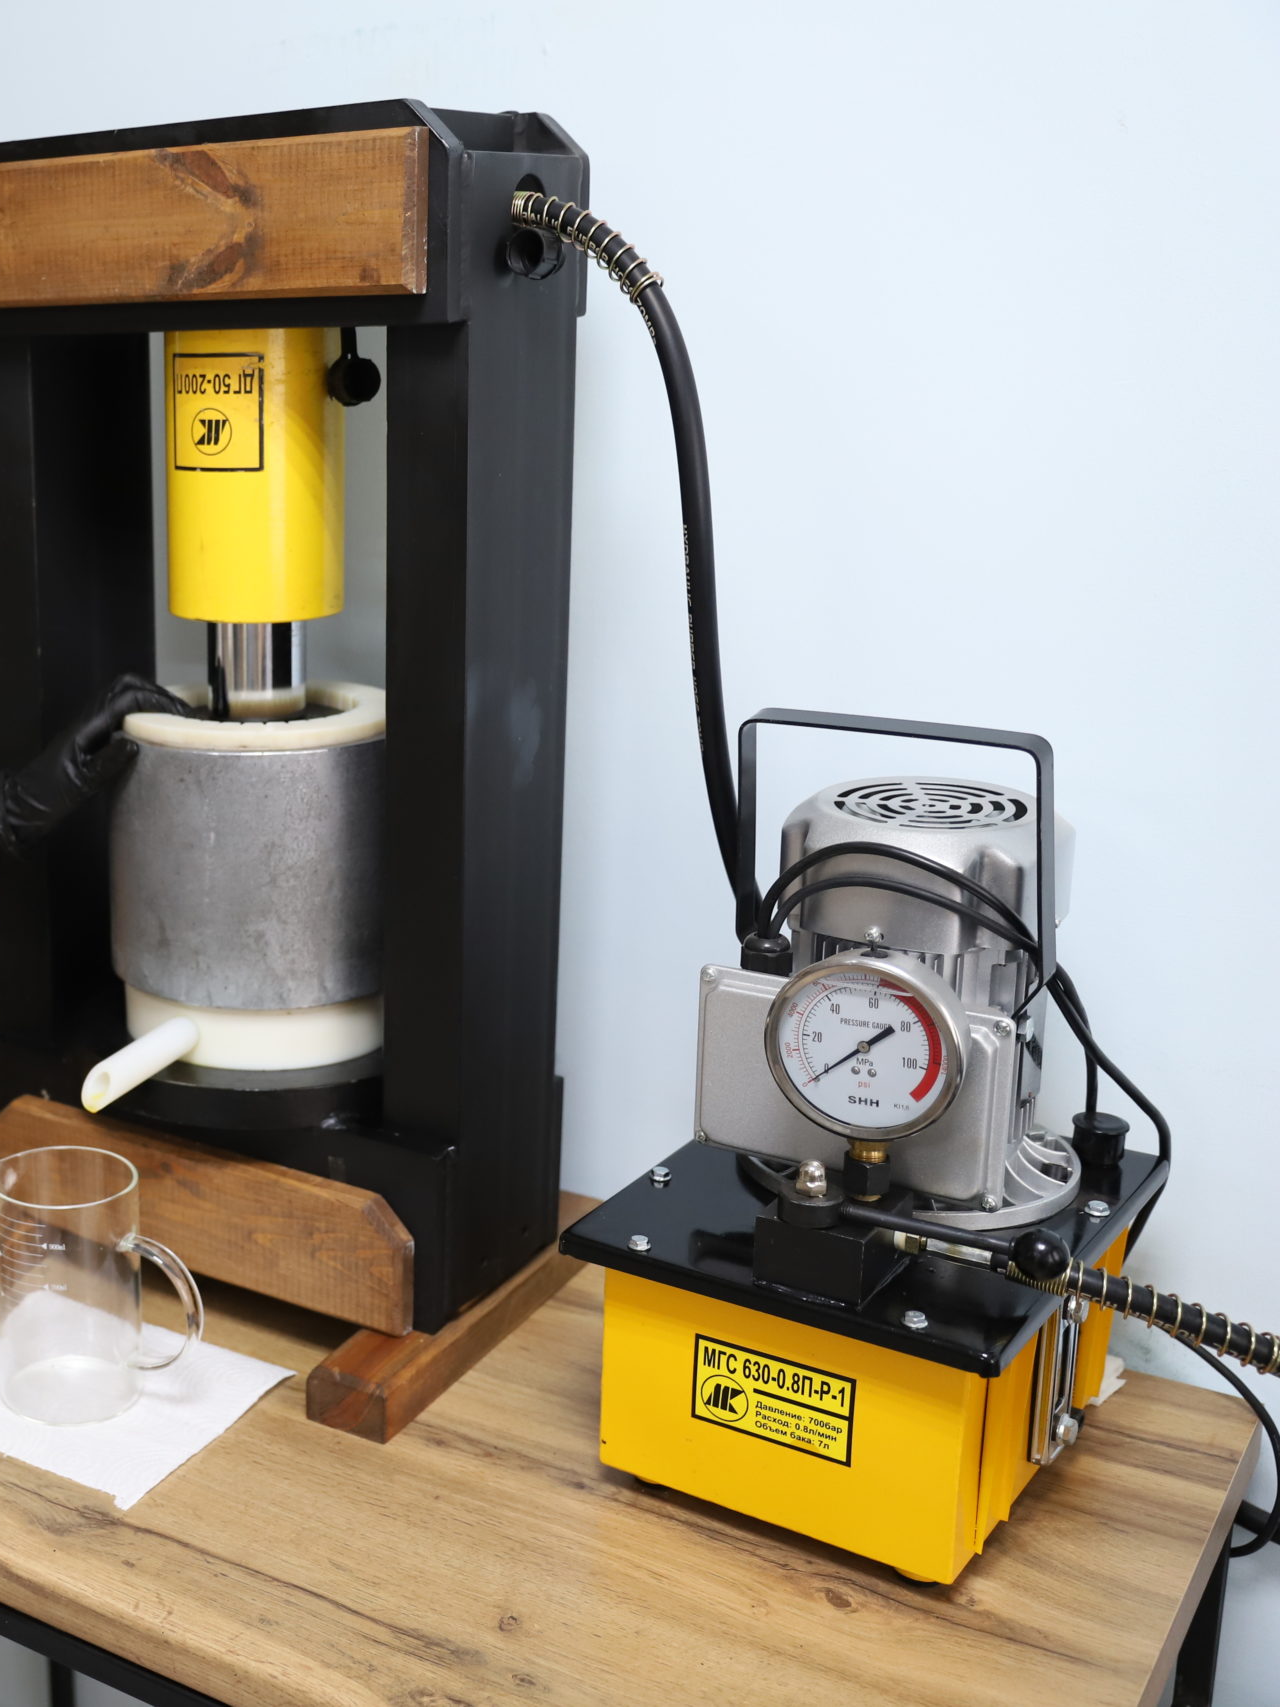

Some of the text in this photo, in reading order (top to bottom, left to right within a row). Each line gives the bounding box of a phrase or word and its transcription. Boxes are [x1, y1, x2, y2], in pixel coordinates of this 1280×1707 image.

[829, 1003, 840, 1015] 40
[868, 997, 879, 1010] 60
[840, 1017, 870, 1028] PRESSURE
[900, 1020, 911, 1033] 80
[812, 1031, 823, 1043] 20
[855, 1057, 874, 1067] MPa
[902, 1056, 918, 1070] 100
[857, 1080, 871, 1089] psi
[847, 1095, 880, 1107] SHH
[703, 1345, 846, 1408] МГС 630-0.8П-Р-1
[755, 1400, 843, 1434] Давление: 700бар
[755, 1410, 837, 1442] Расход: 0.8л/мин
[754, 1420, 830, 1450] Объем бака: 7л
